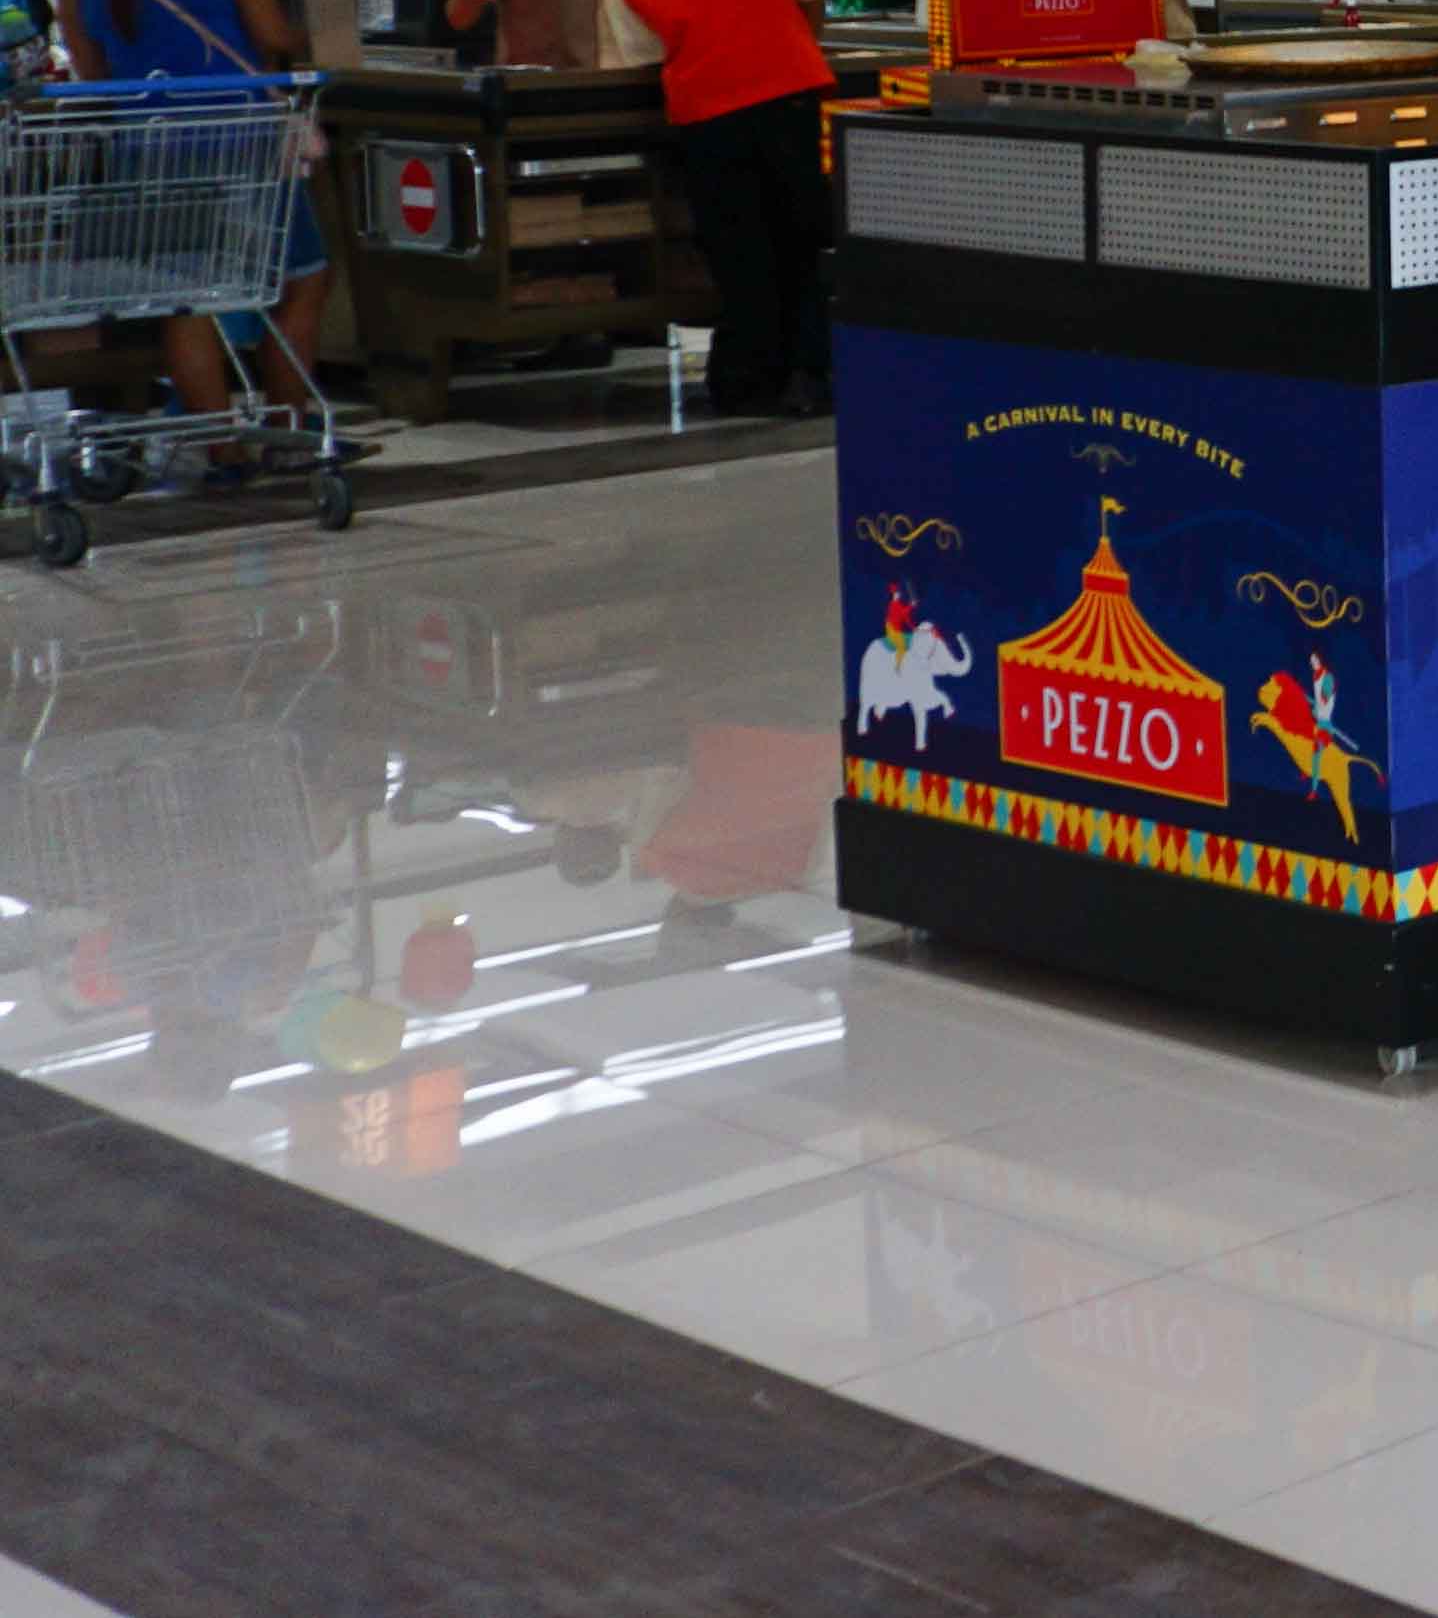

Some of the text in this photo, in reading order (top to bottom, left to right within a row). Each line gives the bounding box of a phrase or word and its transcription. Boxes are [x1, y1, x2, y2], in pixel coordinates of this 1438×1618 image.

[967, 404, 1246, 479] A CARNIVAL IN EVERY BITE
[1041, 687, 1182, 772] PEZZO
